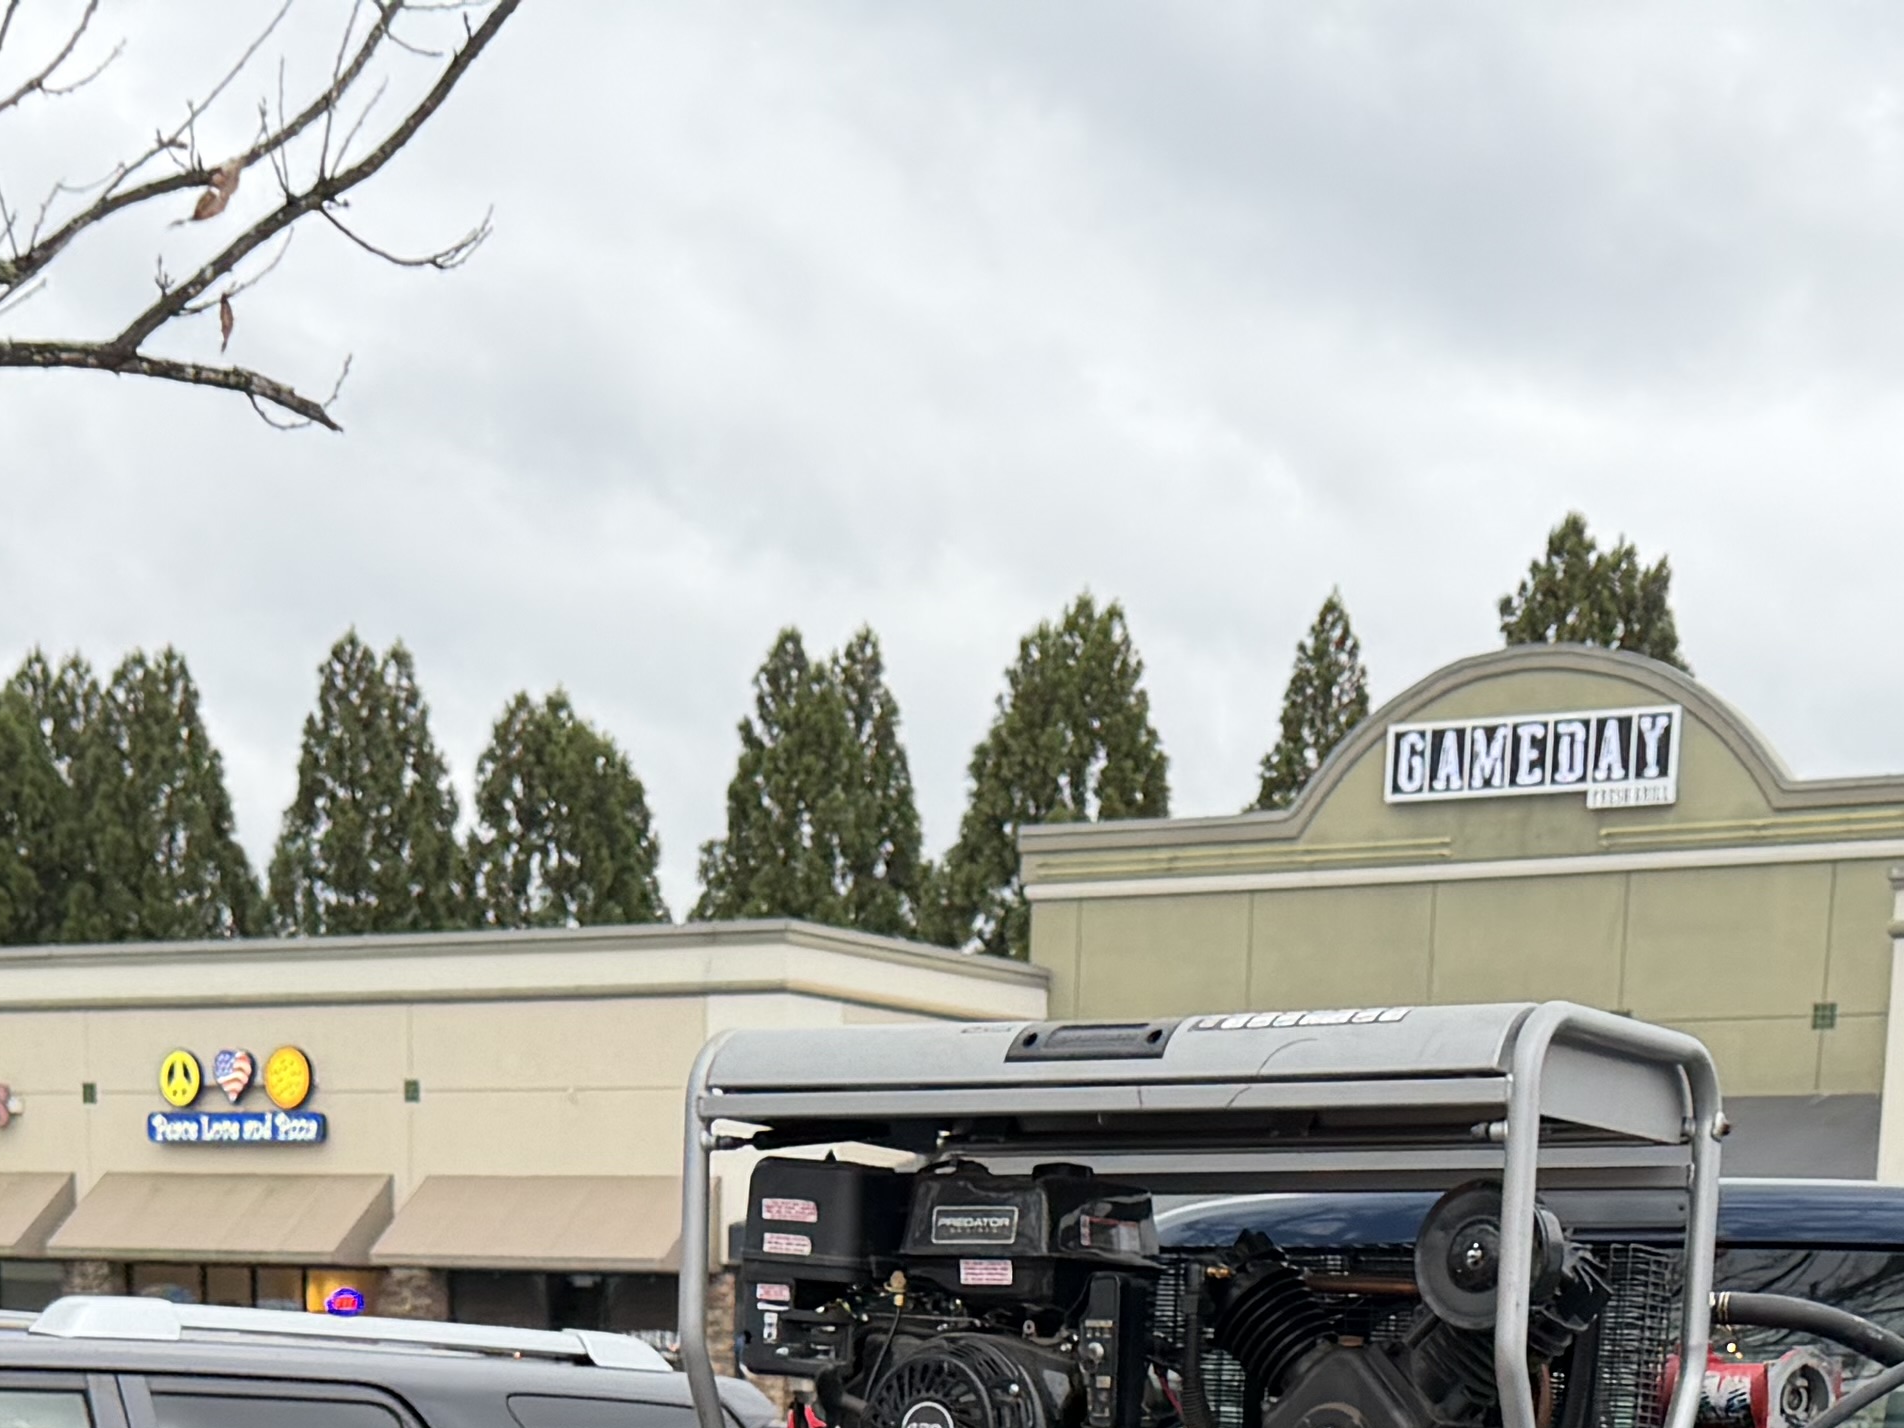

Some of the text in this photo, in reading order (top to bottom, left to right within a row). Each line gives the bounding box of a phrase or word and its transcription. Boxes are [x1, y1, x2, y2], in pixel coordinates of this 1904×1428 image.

[1396, 714, 1670, 793] GAMEDAY
[243, 1112, 272, 1140] and
[937, 1216, 1010, 1228] PREDATOR
